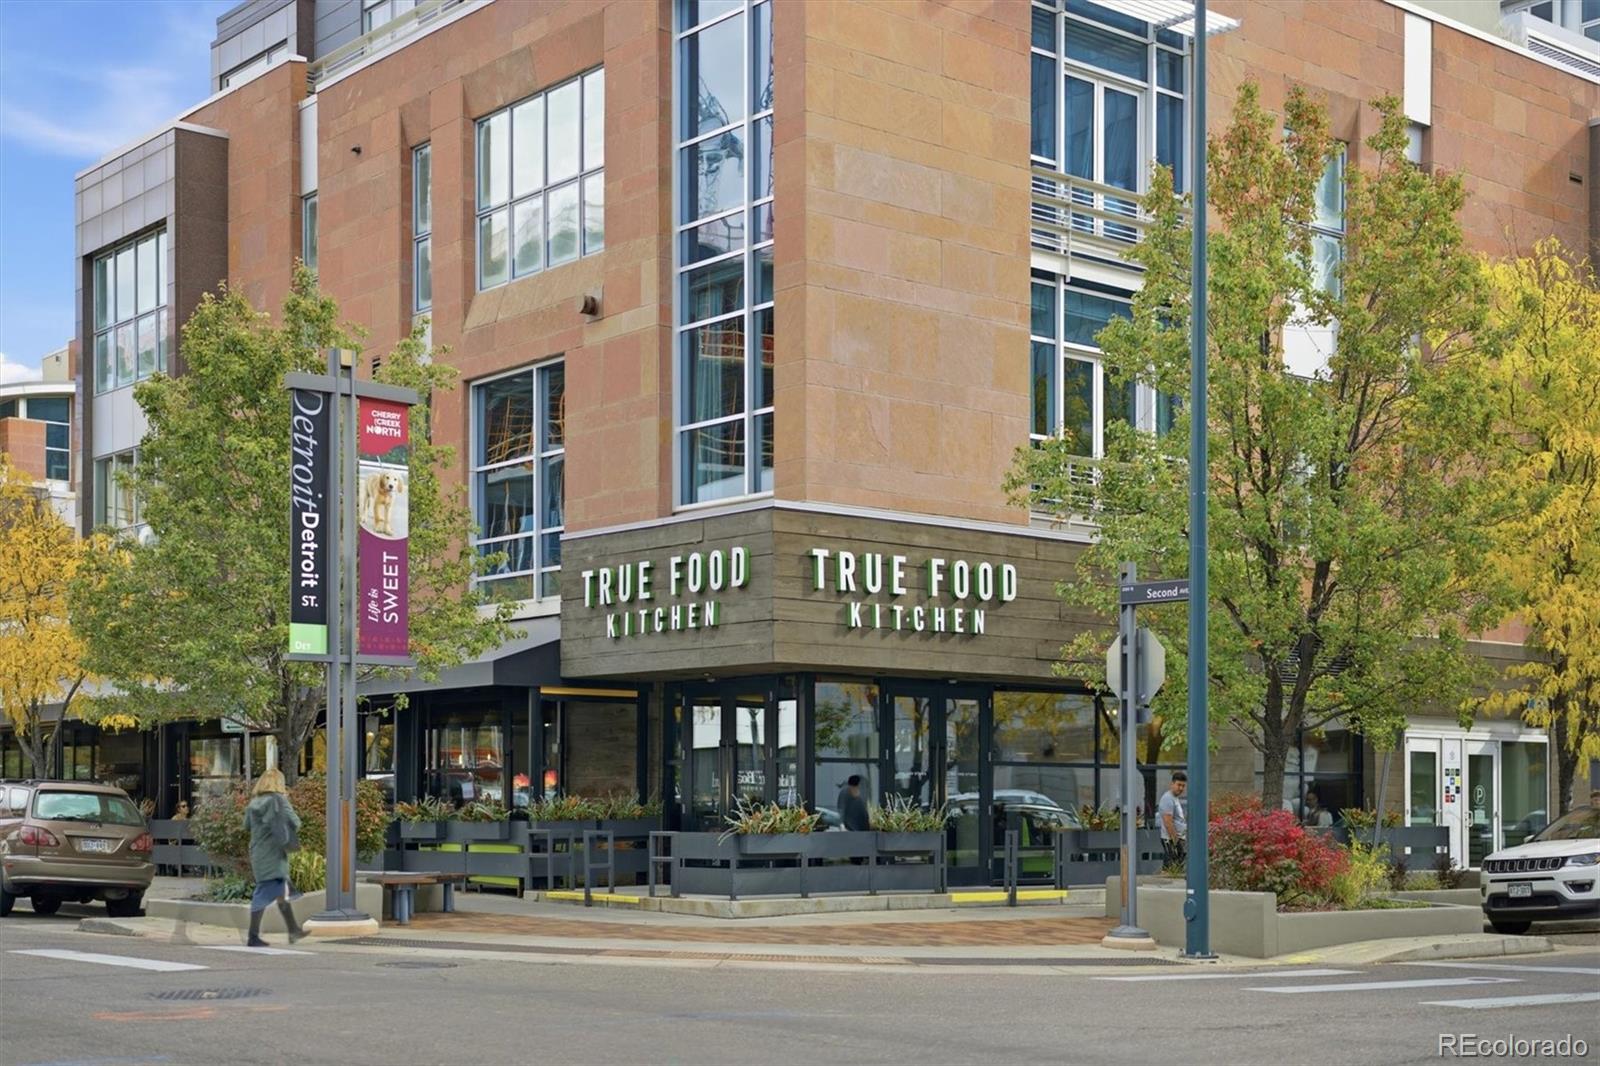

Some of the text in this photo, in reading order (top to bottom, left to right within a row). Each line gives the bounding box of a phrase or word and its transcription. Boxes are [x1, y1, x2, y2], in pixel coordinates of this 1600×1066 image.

[366, 424, 402, 438] NORTH
[371, 409, 402, 420] CHERRY
[376, 418, 401, 428] CREEK
[293, 389, 323, 512] Detroit
[300, 511, 320, 607] Detroit ST.
[581, 546, 748, 608] TRUE FOOD
[811, 547, 1017, 602] TRUE FOOD
[367, 588, 381, 623] Life is
[382, 551, 399, 624] SWEET
[1146, 586, 1178, 599] Second
[606, 600, 717, 639] KITCHEN
[849, 601, 985, 635] KITCHEN
